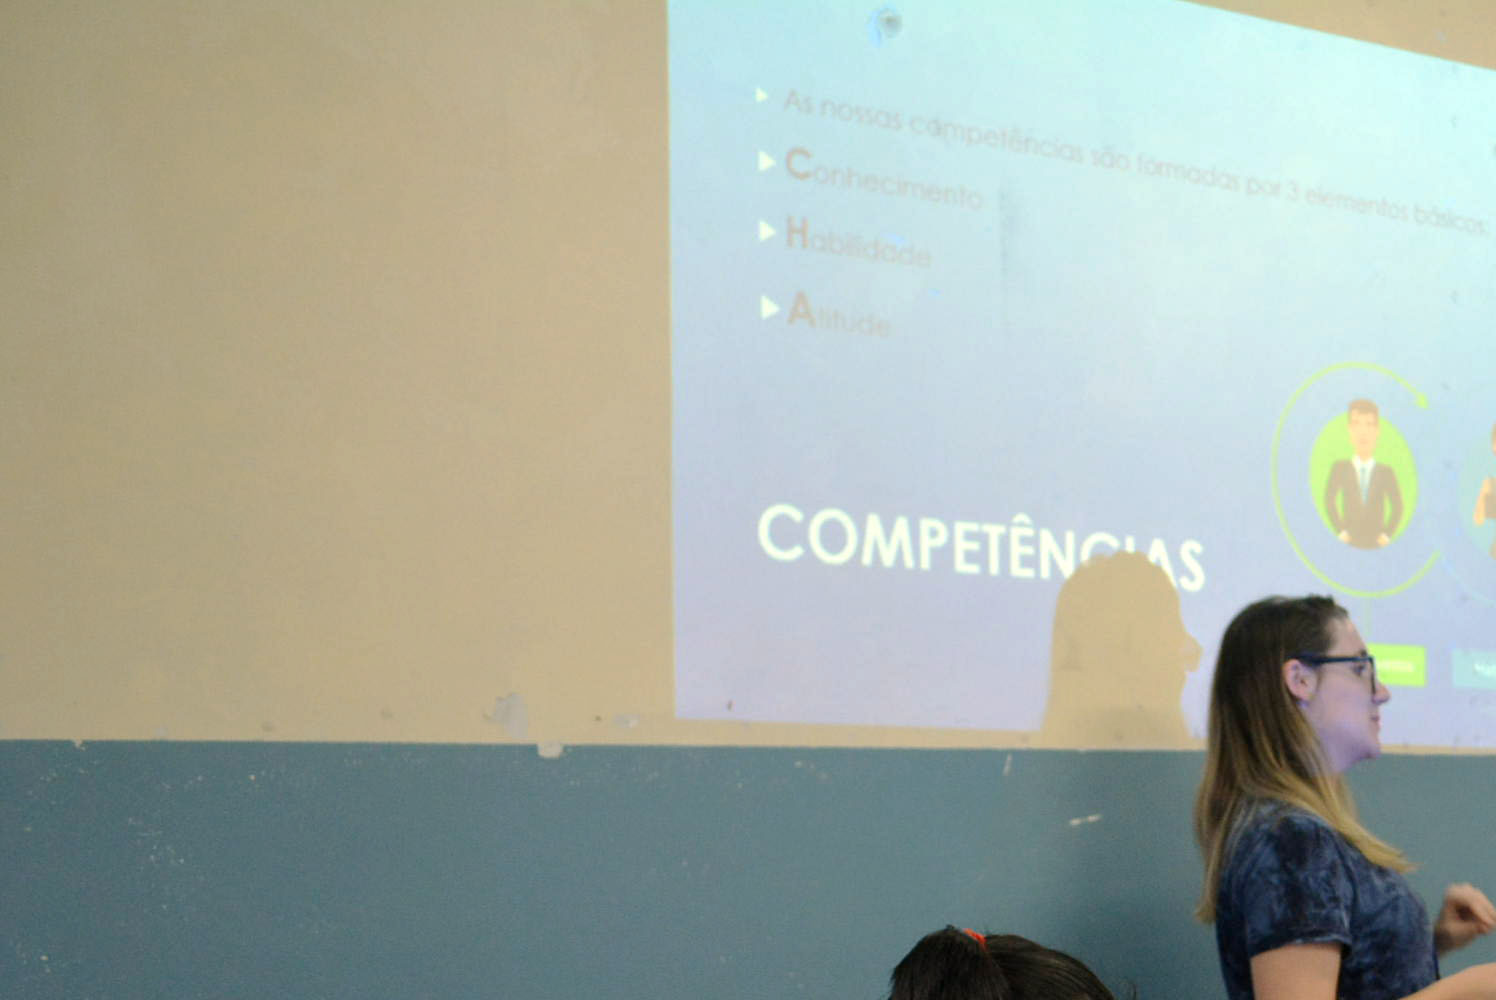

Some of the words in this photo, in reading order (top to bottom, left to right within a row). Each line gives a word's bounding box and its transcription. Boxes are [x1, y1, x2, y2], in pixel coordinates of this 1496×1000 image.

[784, 88, 814, 116] As
[819, 98, 903, 131] nossas
[908, 113, 1085, 166] competências
[1090, 143, 1131, 171] são
[1137, 152, 1241, 194] formadas
[1246, 174, 1282, 198] por
[1286, 180, 1301, 202] 3
[1305, 185, 1410, 223] elementos
[785, 146, 985, 211] Conhecimento
[785, 214, 932, 268] Habilidade
[786, 291, 891, 338] Atitude
[757, 503, 1206, 593] COMPETÊNAS
